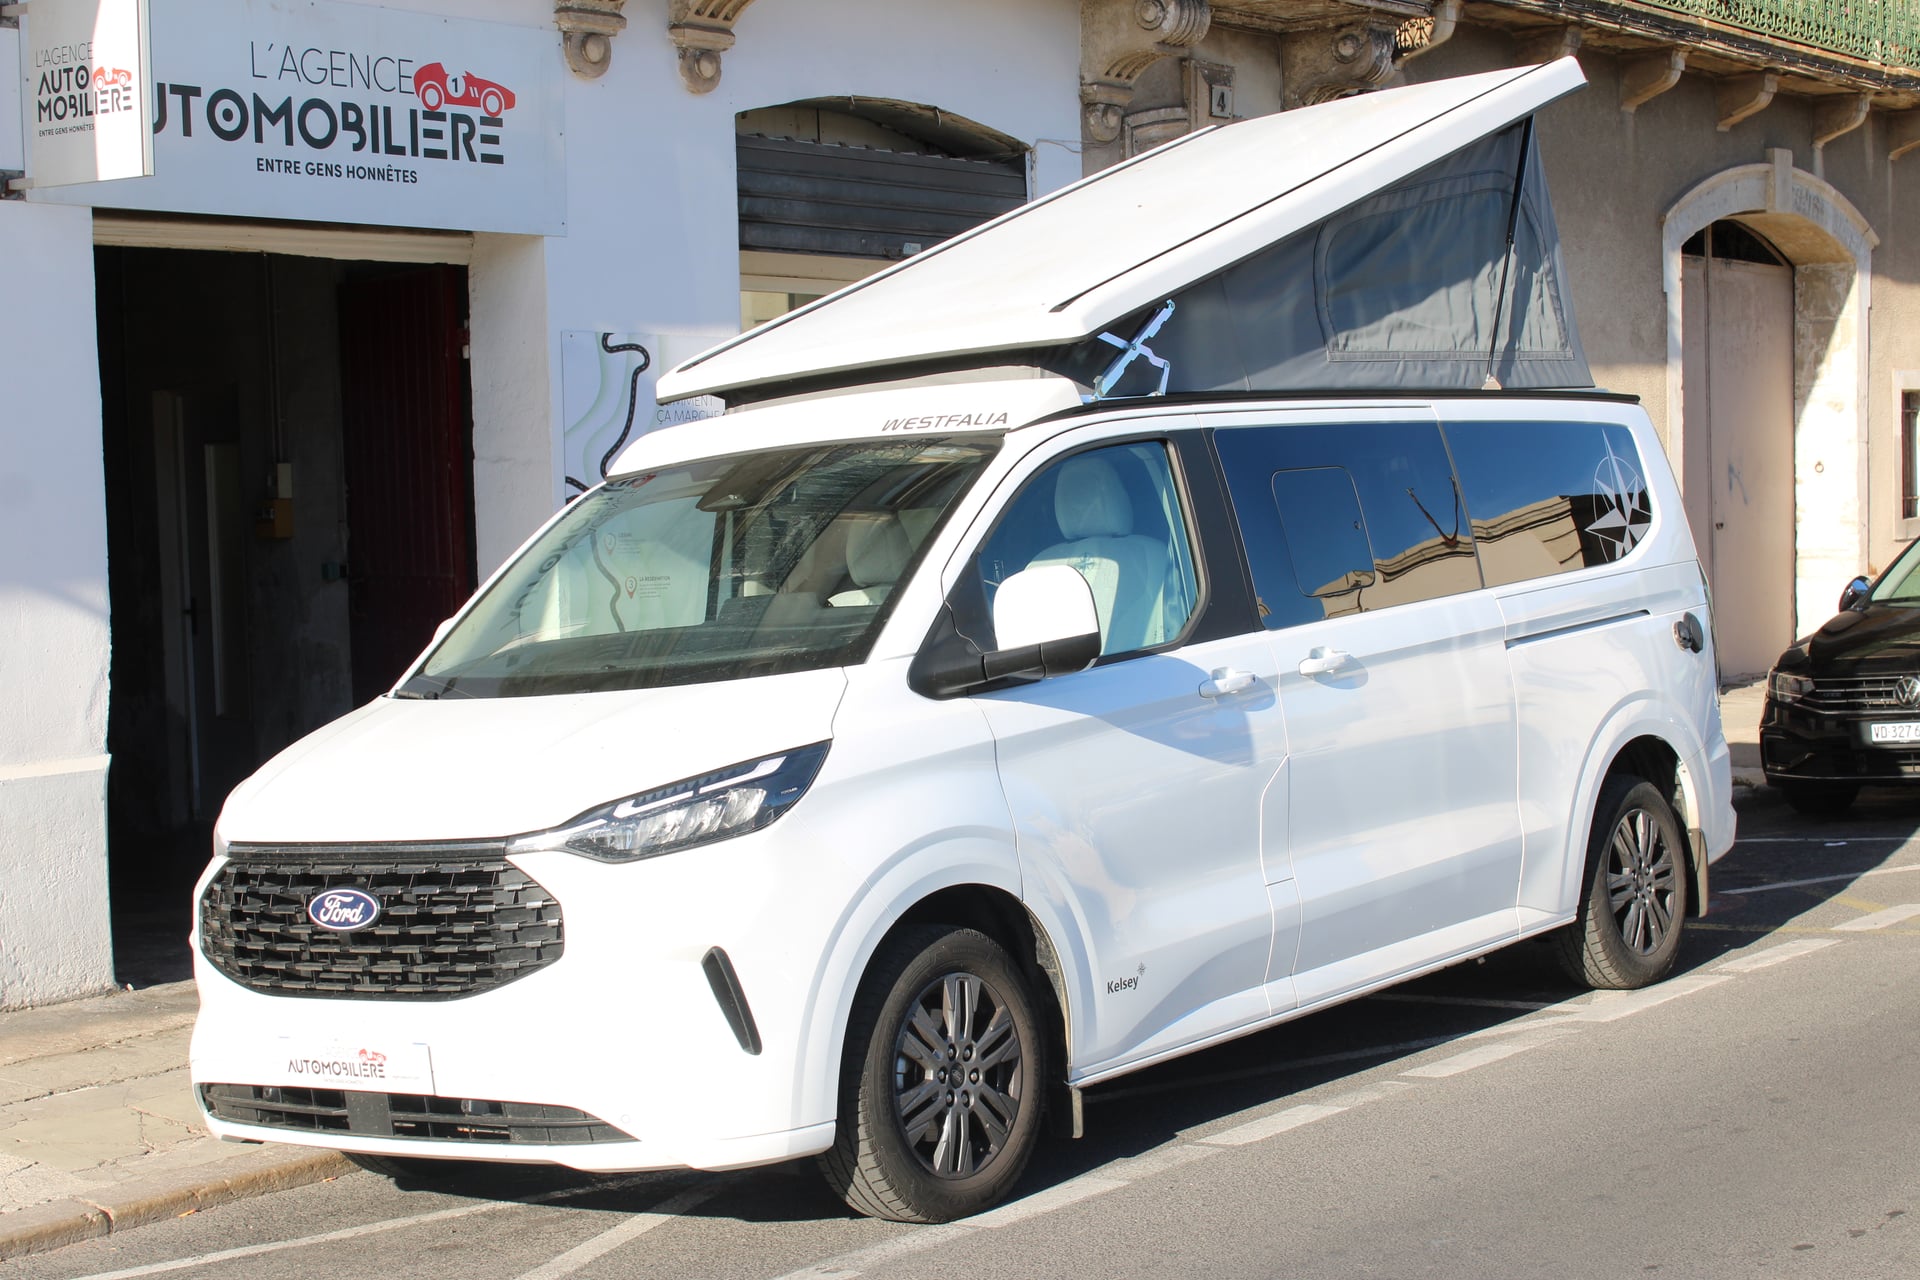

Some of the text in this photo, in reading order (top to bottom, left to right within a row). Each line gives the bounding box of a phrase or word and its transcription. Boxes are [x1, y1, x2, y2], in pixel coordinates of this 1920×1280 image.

[35, 42, 93, 68] L'AGENCE
[251, 41, 415, 95] L'AGENCE
[38, 65, 90, 96] AUTO
[451, 77, 459, 93] 1
[38, 86, 133, 123] MOBILIERE
[1216, 91, 1226, 113] 4
[39, 128, 55, 138] ENTRE
[55, 126, 68, 136] GENS
[153, 82, 505, 165] UTOMOBILIERE
[256, 157, 418, 184] ENTRE GENS HONNÊTES
[656, 409, 672, 425] ÇA
[881, 412, 1009, 432] WESTFALIA
[1873, 726, 1888, 739] VD
[1892, 725, 1912, 739] 327
[319, 894, 365, 923] Ford
[1107, 975, 1139, 995] Kelsey
[287, 1059, 386, 1079] AUTOMOBILIERE
